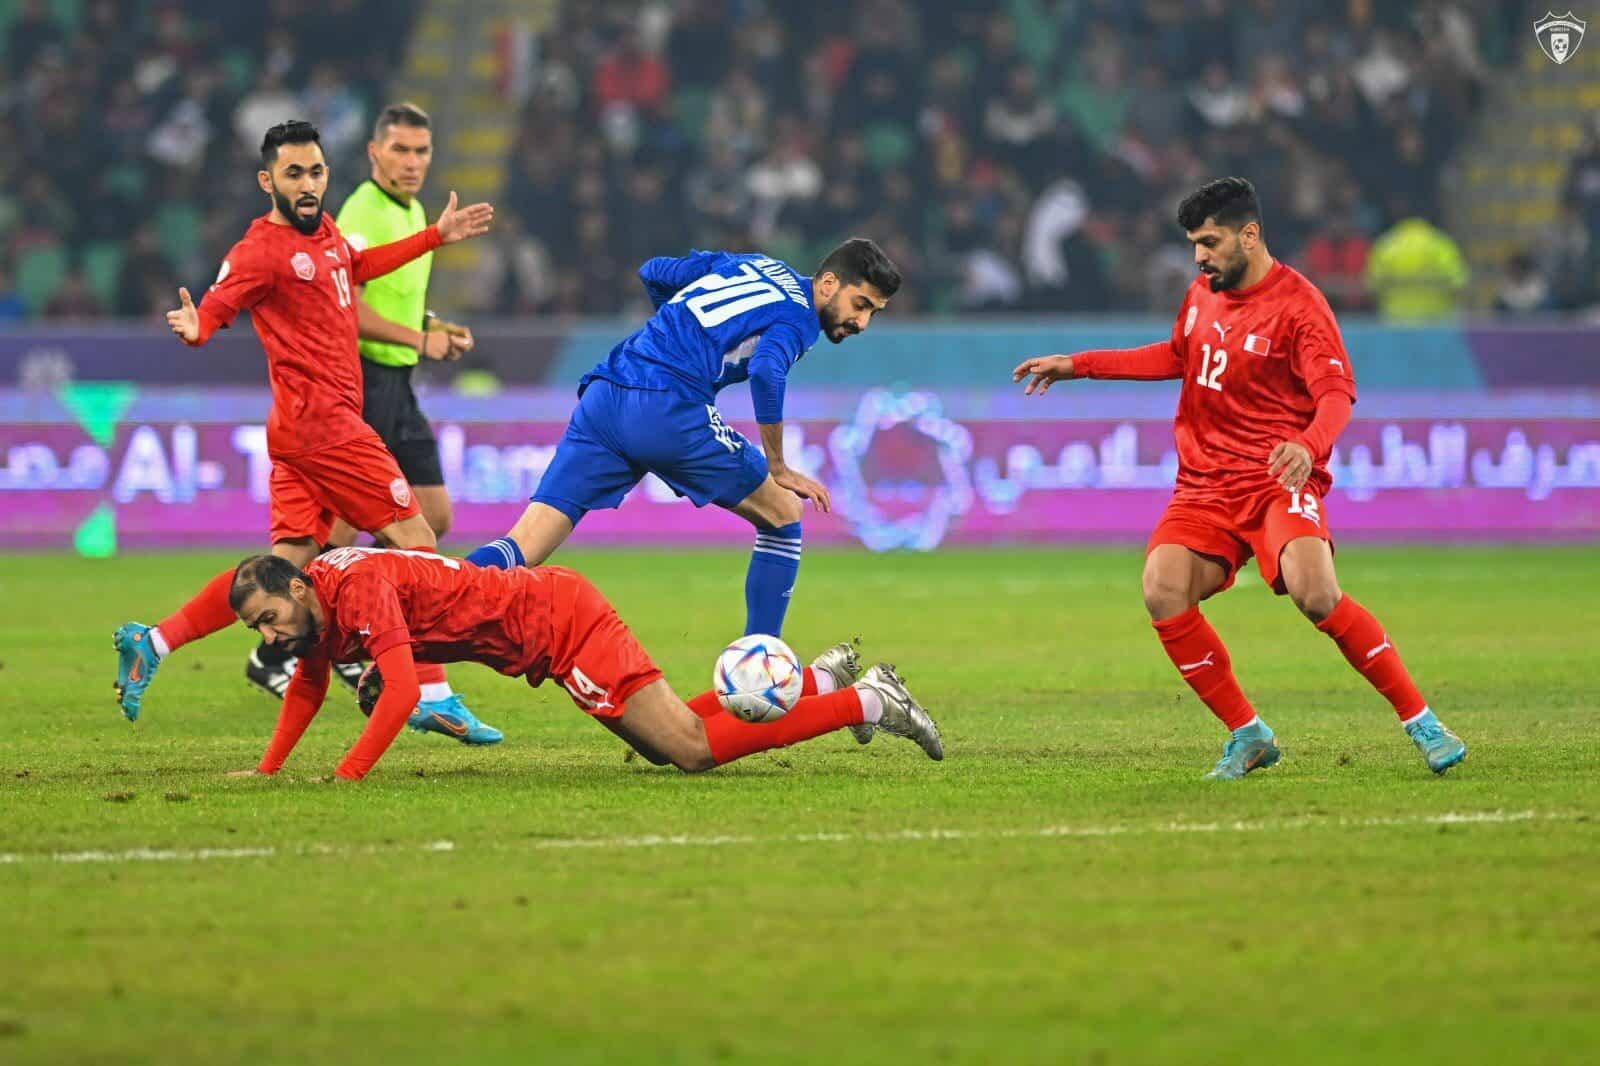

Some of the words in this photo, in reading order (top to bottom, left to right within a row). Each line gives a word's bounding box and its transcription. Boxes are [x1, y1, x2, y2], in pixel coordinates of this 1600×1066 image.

[330, 267, 351, 308] 19
[667, 262, 787, 329] 20
[1196, 343, 1229, 392] 12
[1287, 487, 1320, 519] 12
